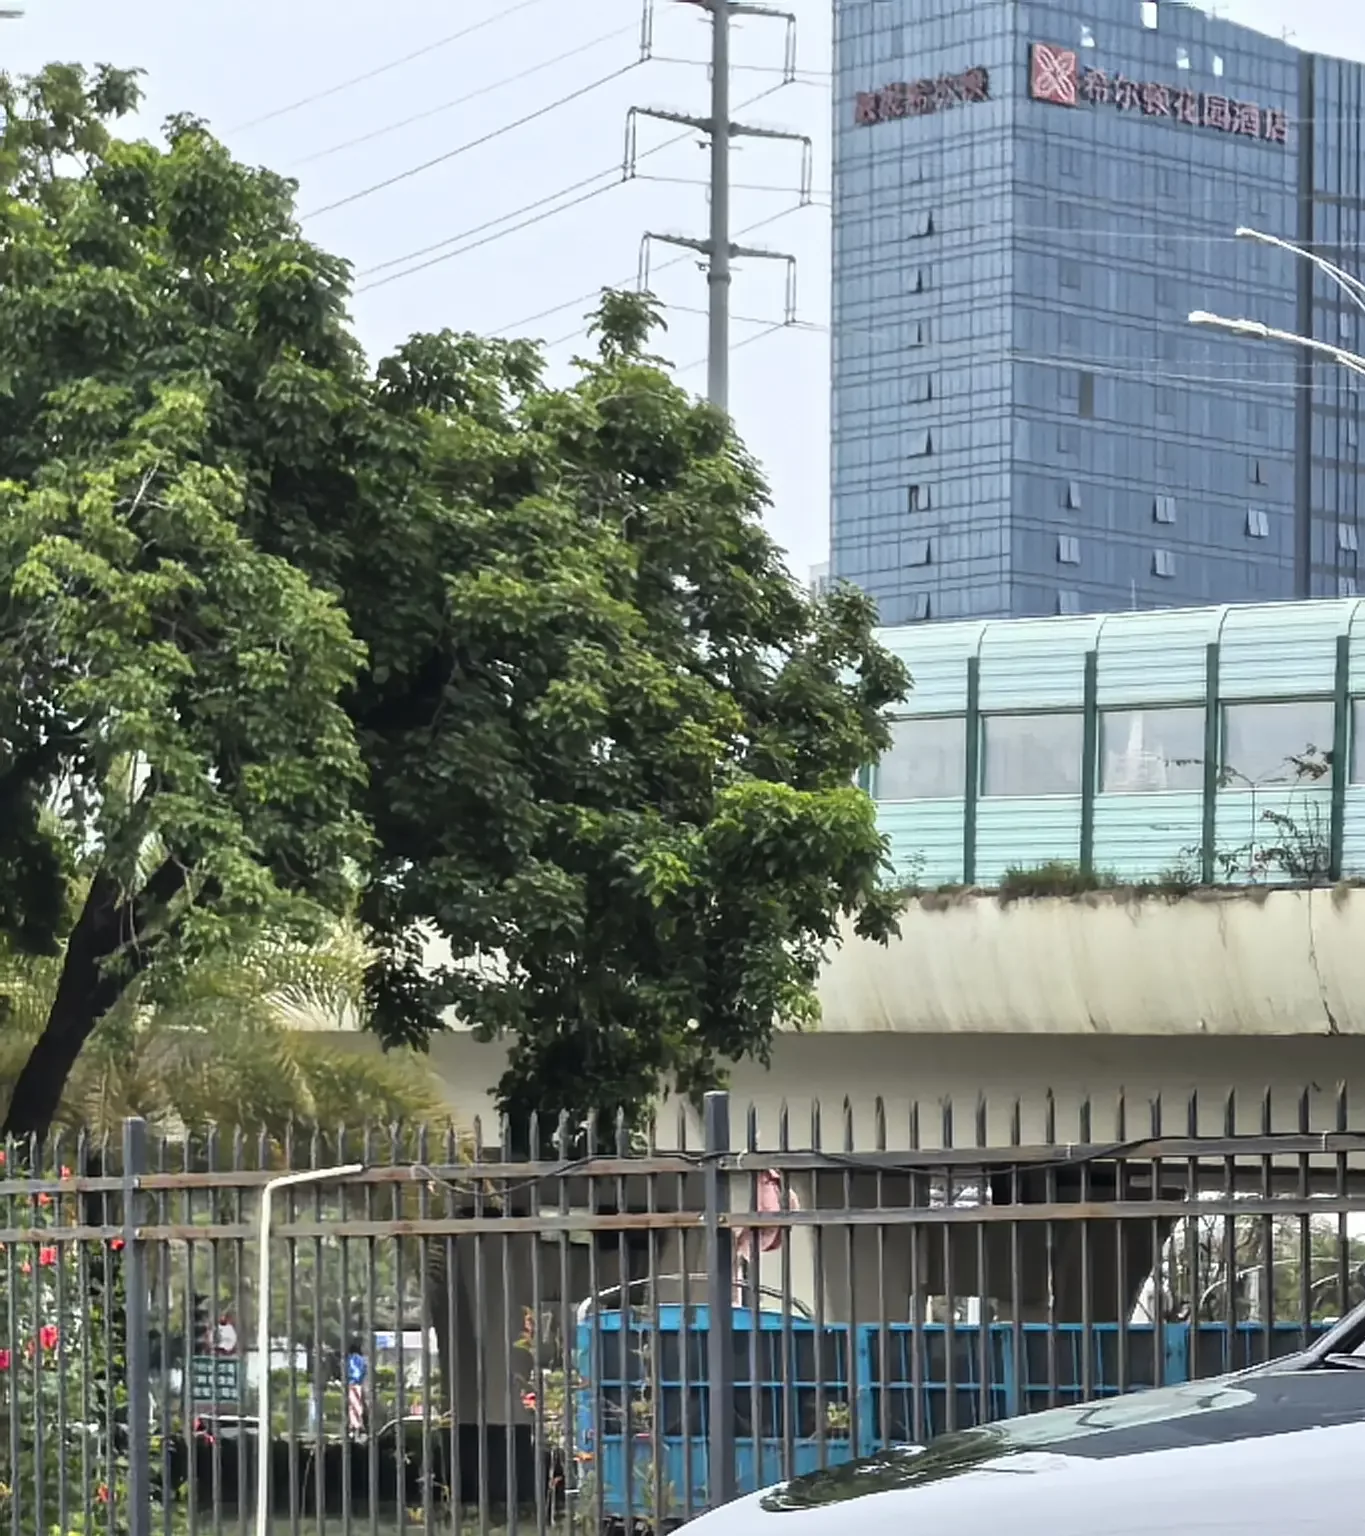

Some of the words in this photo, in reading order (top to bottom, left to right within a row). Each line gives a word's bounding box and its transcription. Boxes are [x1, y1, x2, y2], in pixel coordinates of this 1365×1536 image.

[1083, 66, 1290, 144] 希尔顿花园酒店
